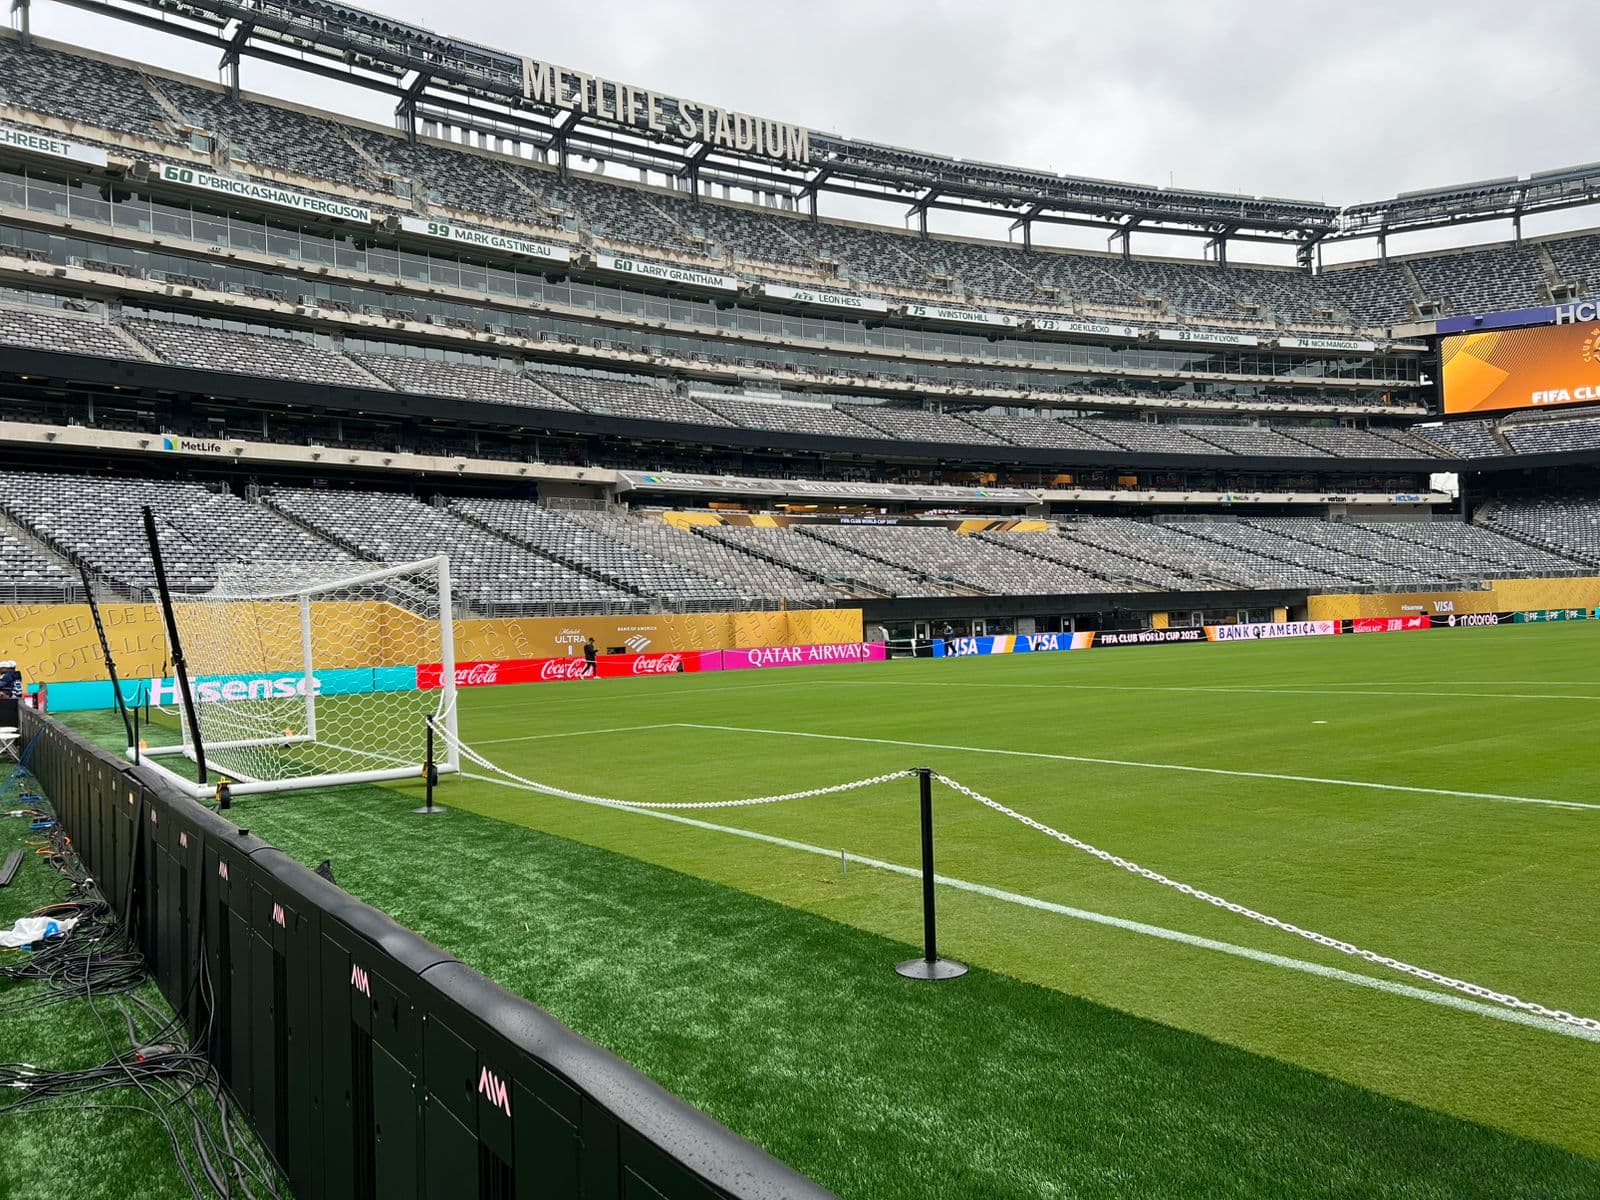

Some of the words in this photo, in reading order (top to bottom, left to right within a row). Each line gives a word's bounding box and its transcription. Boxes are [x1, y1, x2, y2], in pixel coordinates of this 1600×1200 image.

[522, 56, 666, 132] METLIFE
[678, 99, 809, 163] STADIUM
[164, 165, 193, 183] 60
[198, 174, 301, 206] D'BRICKASHAW
[302, 197, 368, 221] FERGUSON
[427, 222, 450, 237] 99
[454, 229, 489, 245] MARK
[491, 237, 551, 256] GASTINEAU
[614, 258, 632, 271] 60
[636, 263, 668, 278] LARRY
[669, 270, 723, 287] GRANTHAM
[818, 294, 840, 305] LEON
[841, 298, 862, 307] HESS
[912, 305, 927, 316] 75
[937, 309, 973, 321] WINSTON
[973, 314, 989, 322] HILL
[1556, 301, 1600, 325] HC
[1042, 320, 1054, 330] 73
[1069, 323, 1082, 331] JOE
[1082, 325, 1110, 333] KLECKO
[1178, 331, 1191, 340] 93
[1296, 338, 1309, 347] 74
[1532, 389, 1570, 404] FIFA
[181, 441, 221, 452] MetLife
[1433, 601, 1454, 612] VISA
[1460, 612, 1498, 627] motorola
[12, 605, 137, 654] SOCIEDDE
[1218, 626, 1253, 639] BANK
[1253, 626, 1266, 636] OF
[1268, 623, 1316, 635] AMERICA
[554, 635, 587, 644] ULTRA
[1026, 634, 1059, 651] VISA
[1101, 634, 1118, 644] FIFA
[1119, 633, 1137, 643] CLUB
[1138, 632, 1164, 643] WORLD
[1165, 631, 1180, 641] CUP
[748, 646, 801, 667] QATAR
[808, 643, 870, 661] AIRWAYS
